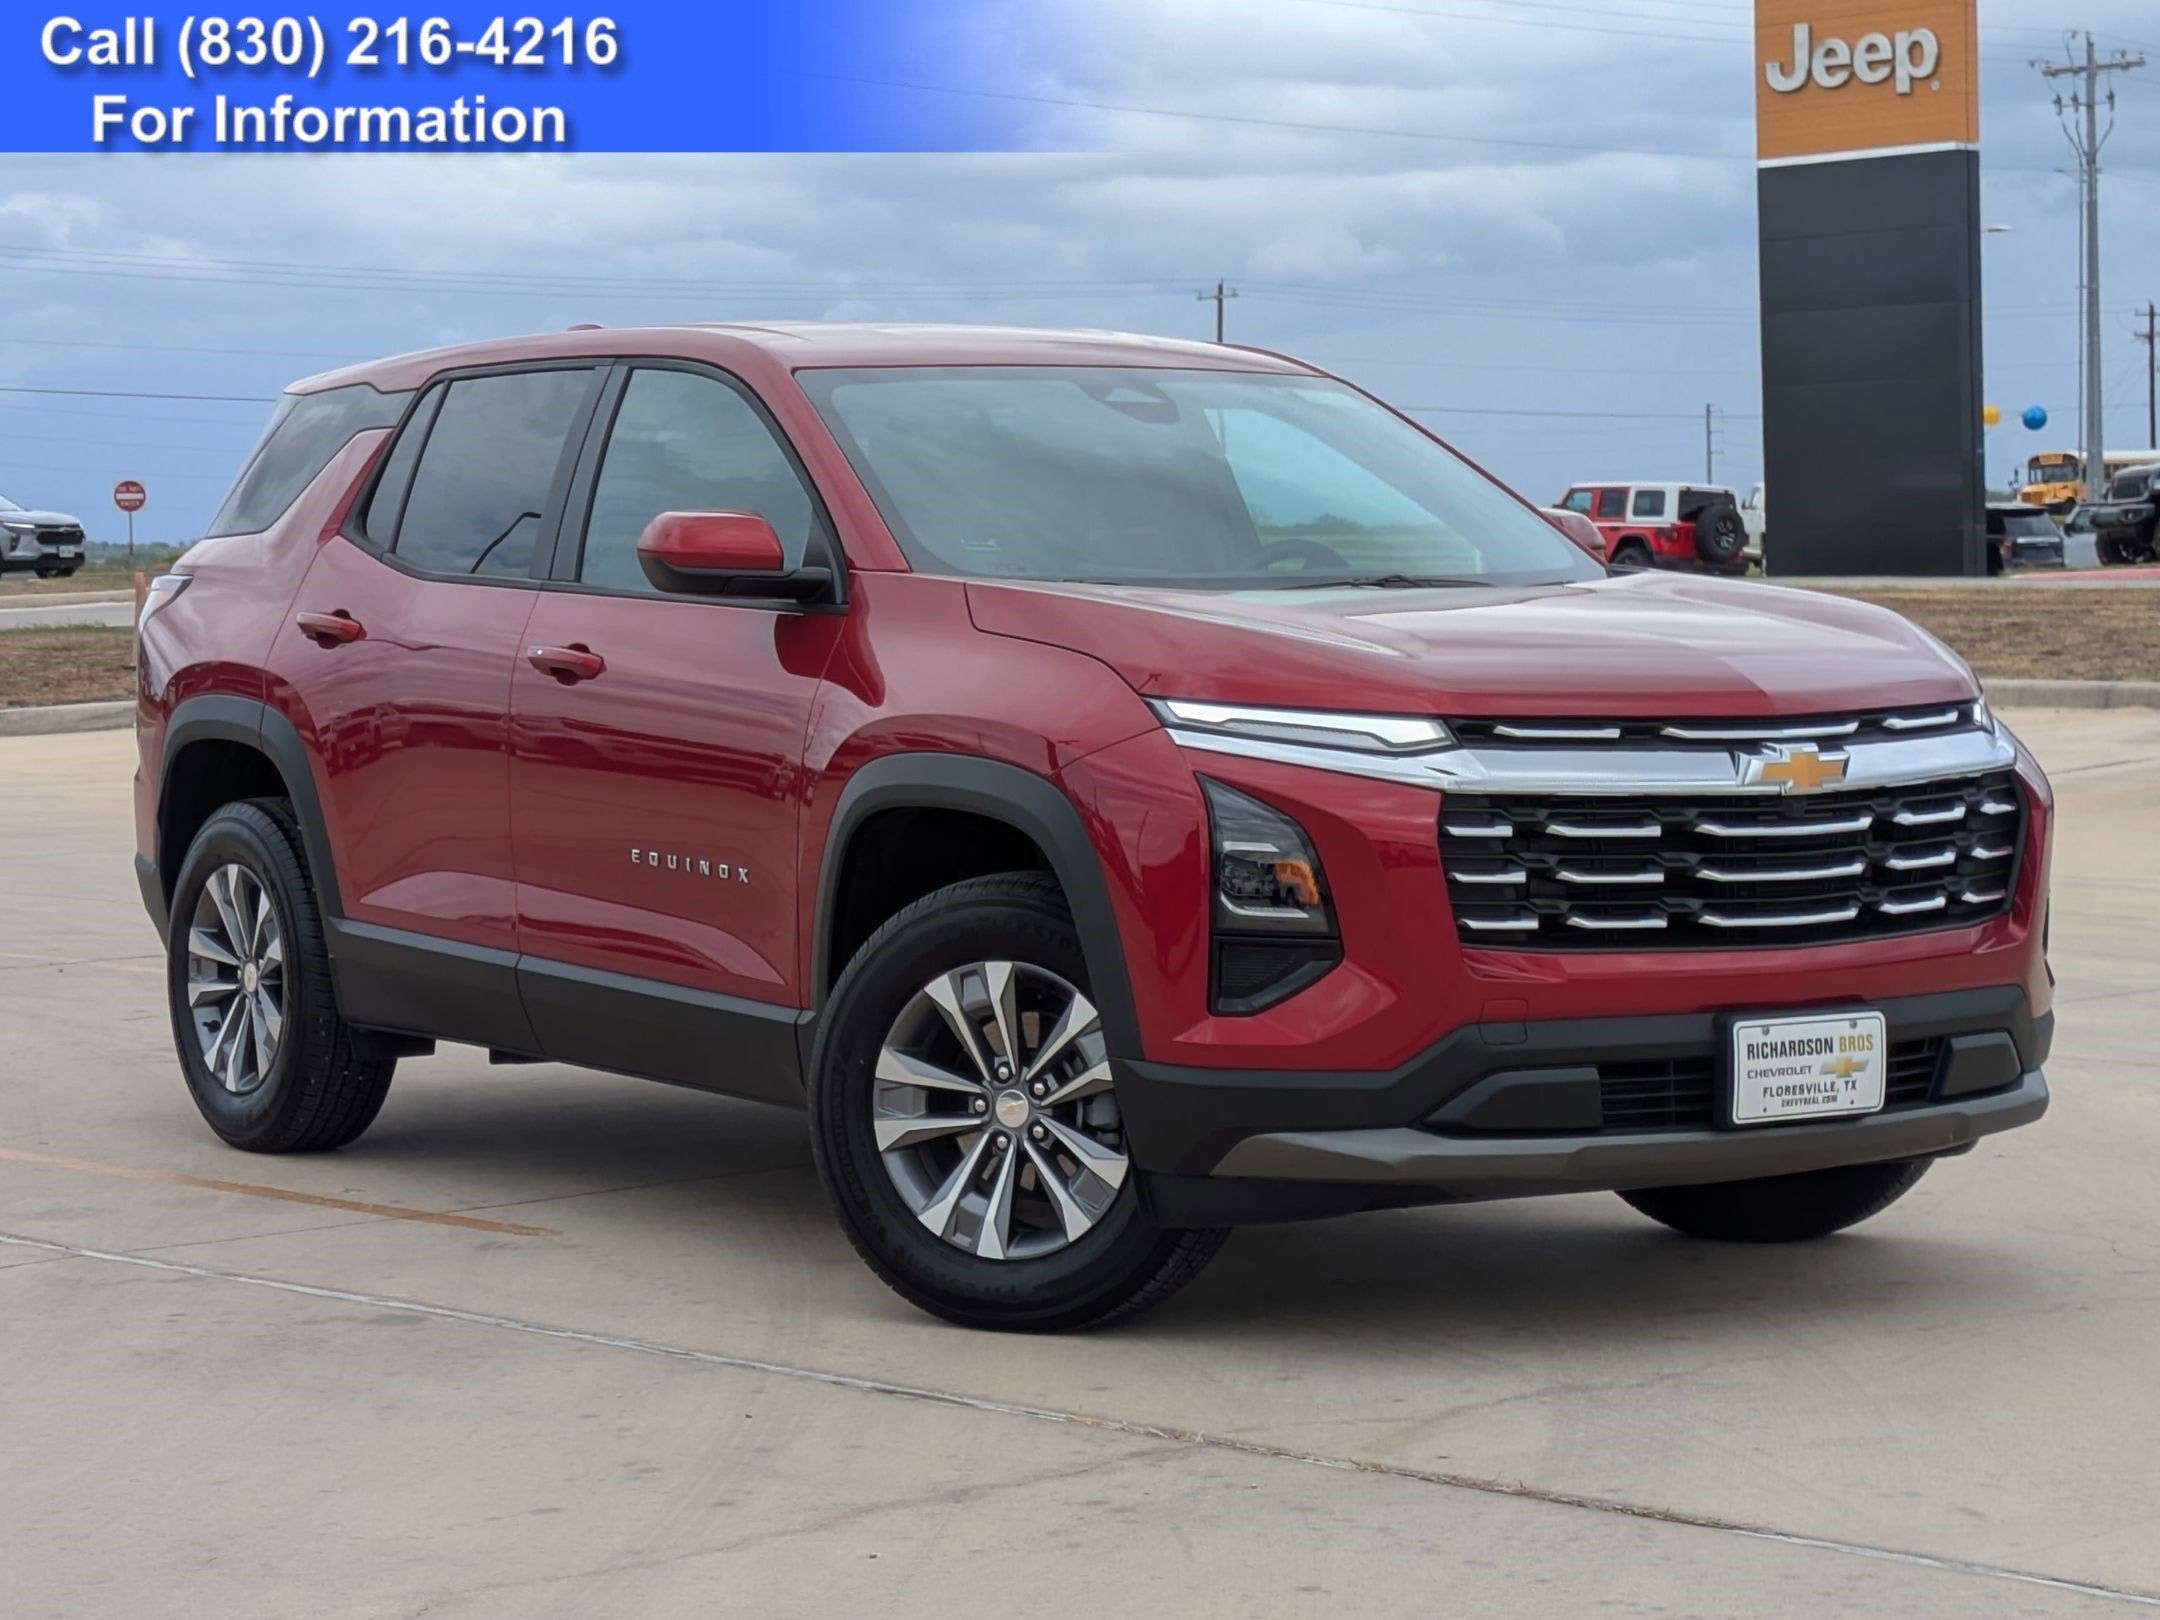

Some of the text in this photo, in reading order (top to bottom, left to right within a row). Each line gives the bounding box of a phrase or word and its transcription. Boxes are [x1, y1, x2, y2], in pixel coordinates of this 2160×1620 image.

[1765, 22, 1939, 95] Jeep
[631, 849, 749, 883] EQUINOX
[1747, 1034, 1874, 1061] RICHARDSON BROS
[1747, 1065, 1813, 1079] CHEVROLET
[1762, 1080, 1857, 1099] FLORESVILLE, TX
